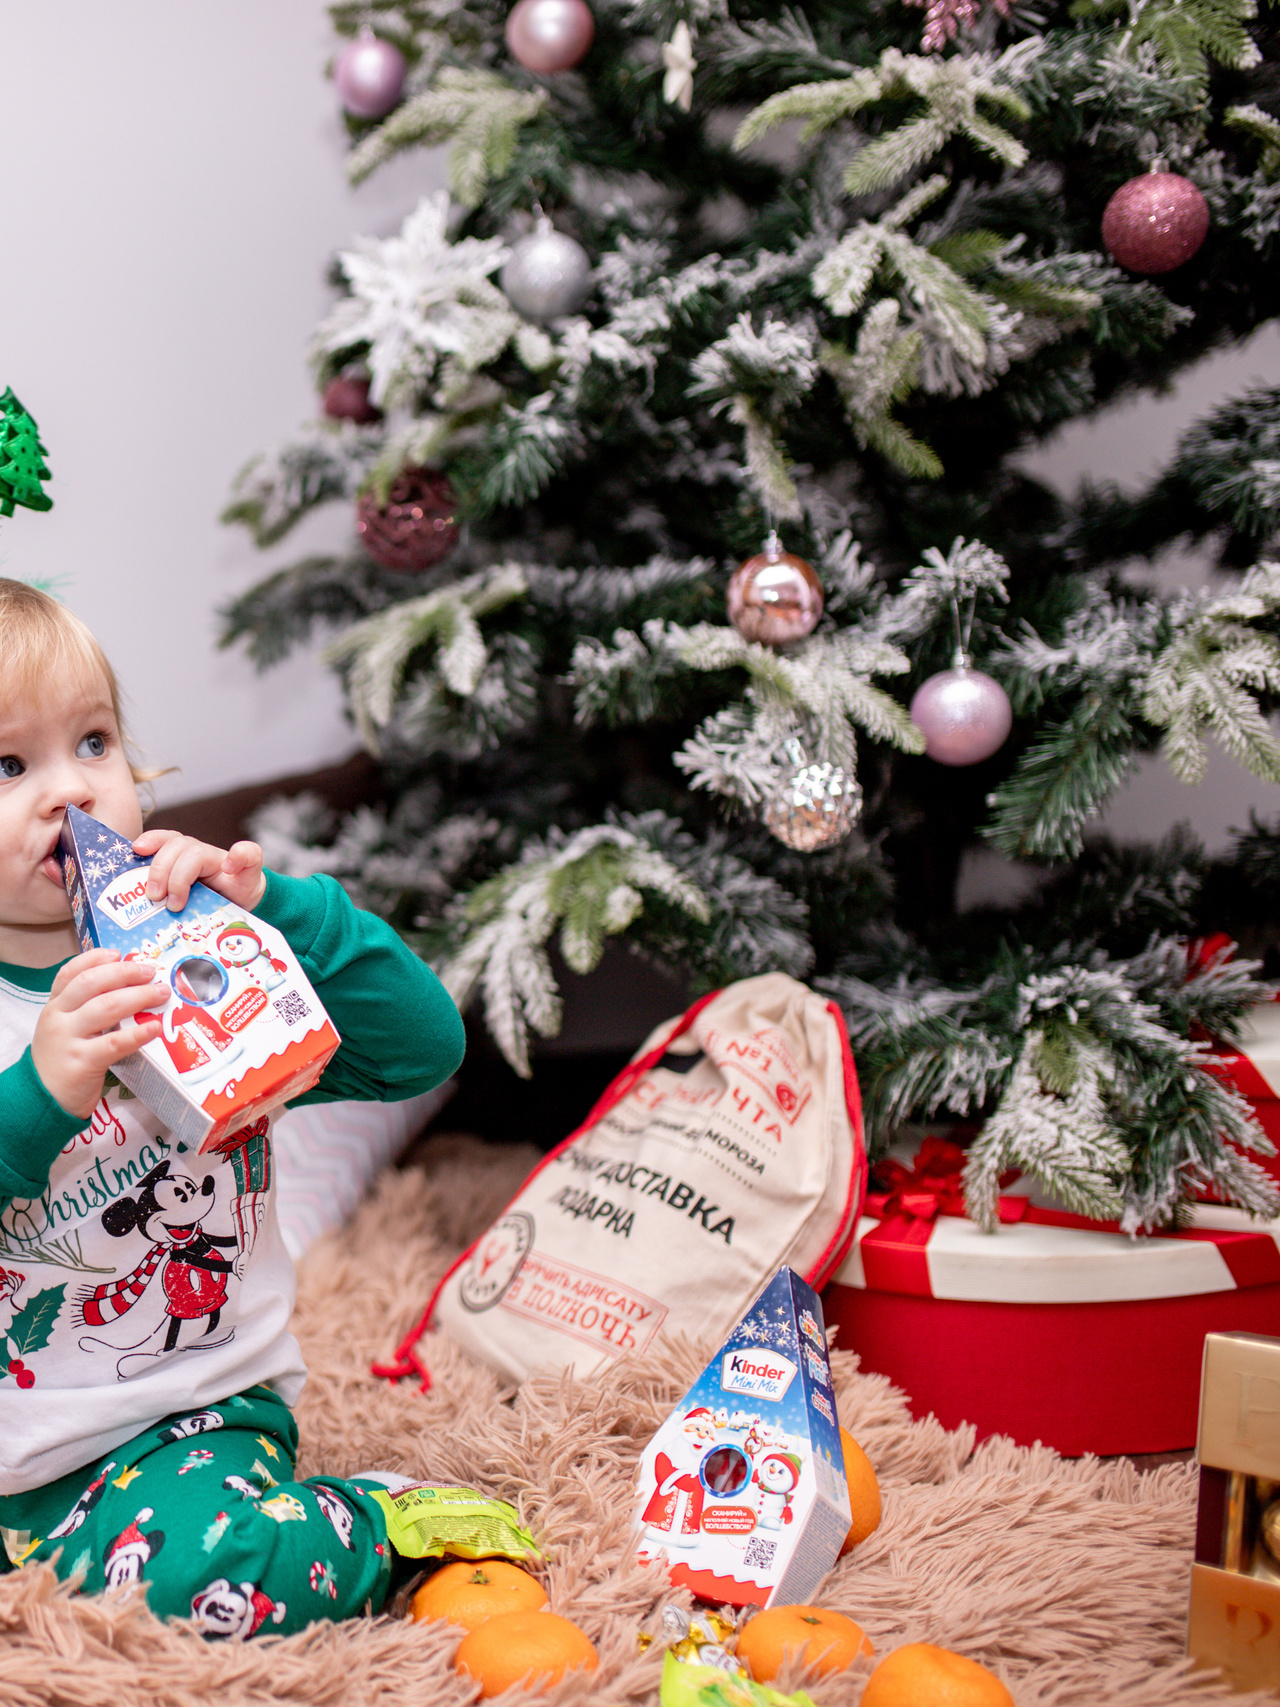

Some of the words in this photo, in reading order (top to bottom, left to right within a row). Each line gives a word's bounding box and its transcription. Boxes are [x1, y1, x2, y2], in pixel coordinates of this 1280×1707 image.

[106, 881, 148, 911] Kind
[732, 1086, 782, 1143] ЧТА
[705, 1128, 768, 1176] МОРОЗА
[522, 1283, 637, 1350] ПОЛНОЧЬ
[570, 1279, 654, 1322] АДРЕСАТУ
[730, 1355, 786, 1381] Kinder
[730, 1375, 757, 1389] Mini
[757, 1379, 779, 1393] Mix
